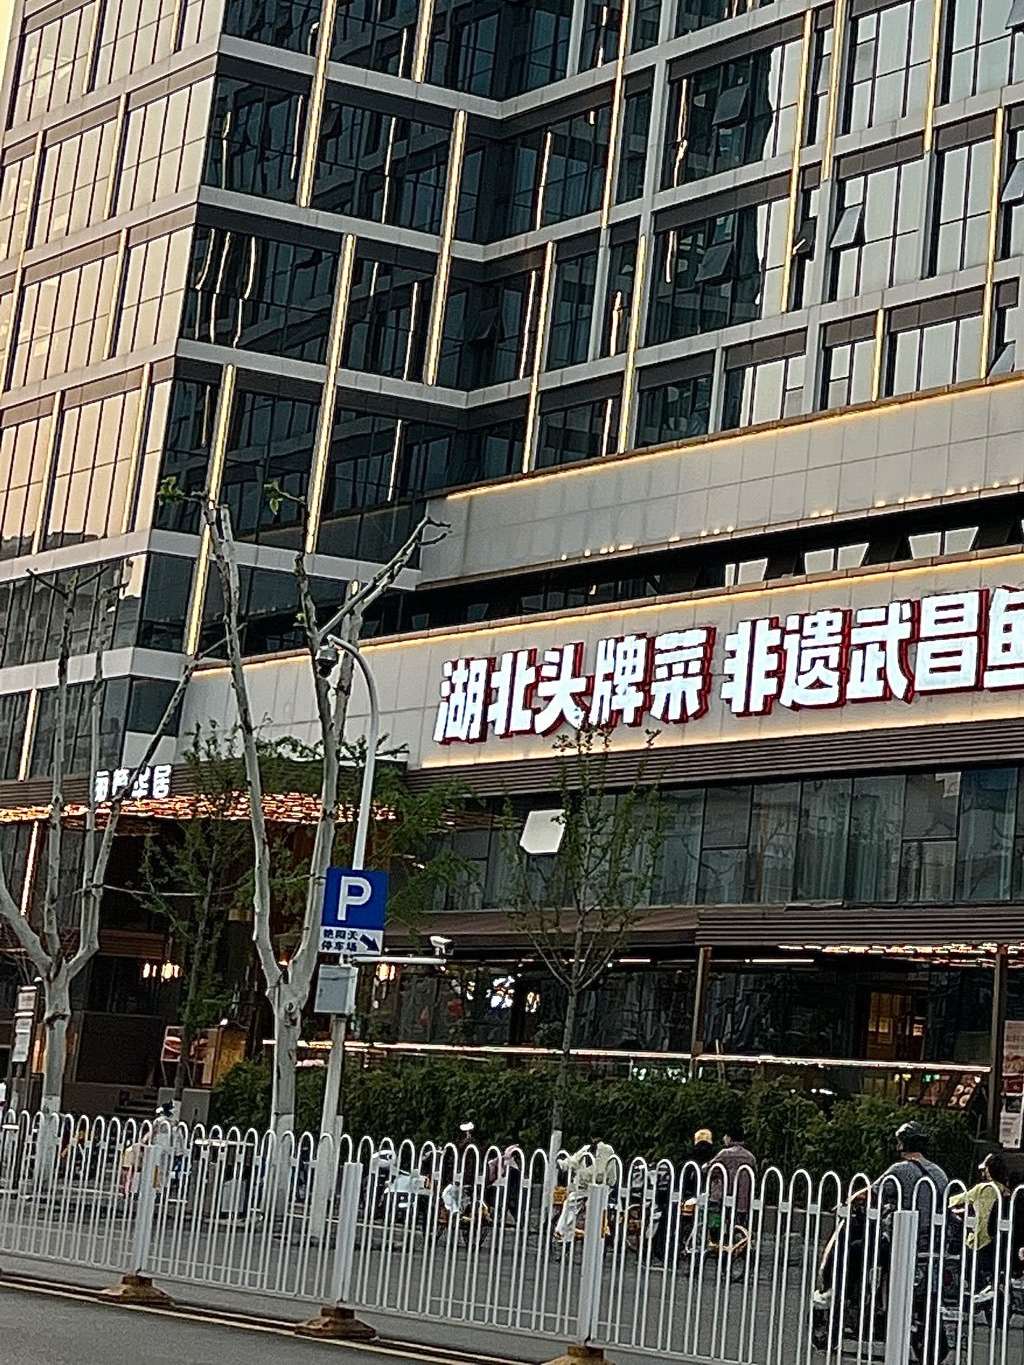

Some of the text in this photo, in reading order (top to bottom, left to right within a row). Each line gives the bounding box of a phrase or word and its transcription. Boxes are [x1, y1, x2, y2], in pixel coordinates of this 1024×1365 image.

[433, 628, 712, 744] 湖北头牌菜
[337, 875, 372, 921] P
[321, 940, 358, 952] 停车场
[323, 929, 358, 941] 艳阳天
